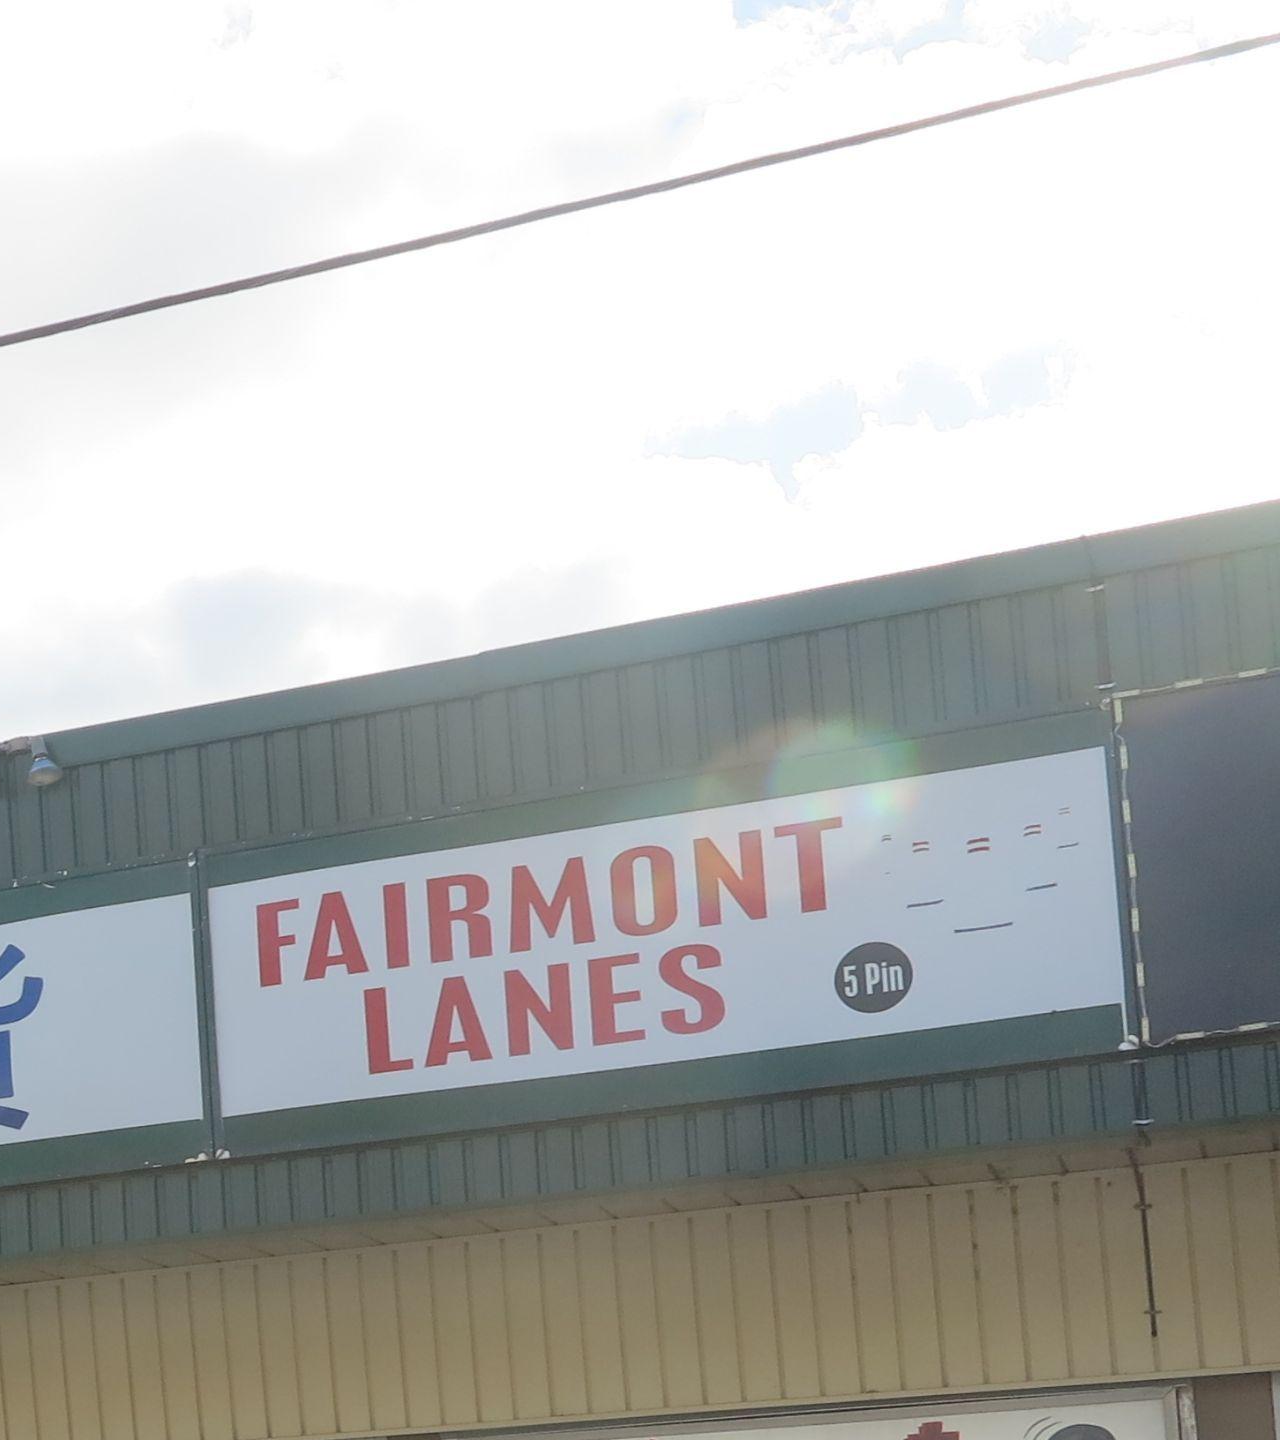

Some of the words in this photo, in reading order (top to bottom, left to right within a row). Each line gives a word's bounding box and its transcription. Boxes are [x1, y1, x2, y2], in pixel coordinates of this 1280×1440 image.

[255, 816, 843, 988] FAIRMONT
[363, 943, 727, 1075] LANES
[843, 965, 858, 997] 5
[865, 961, 904, 994] Pin
